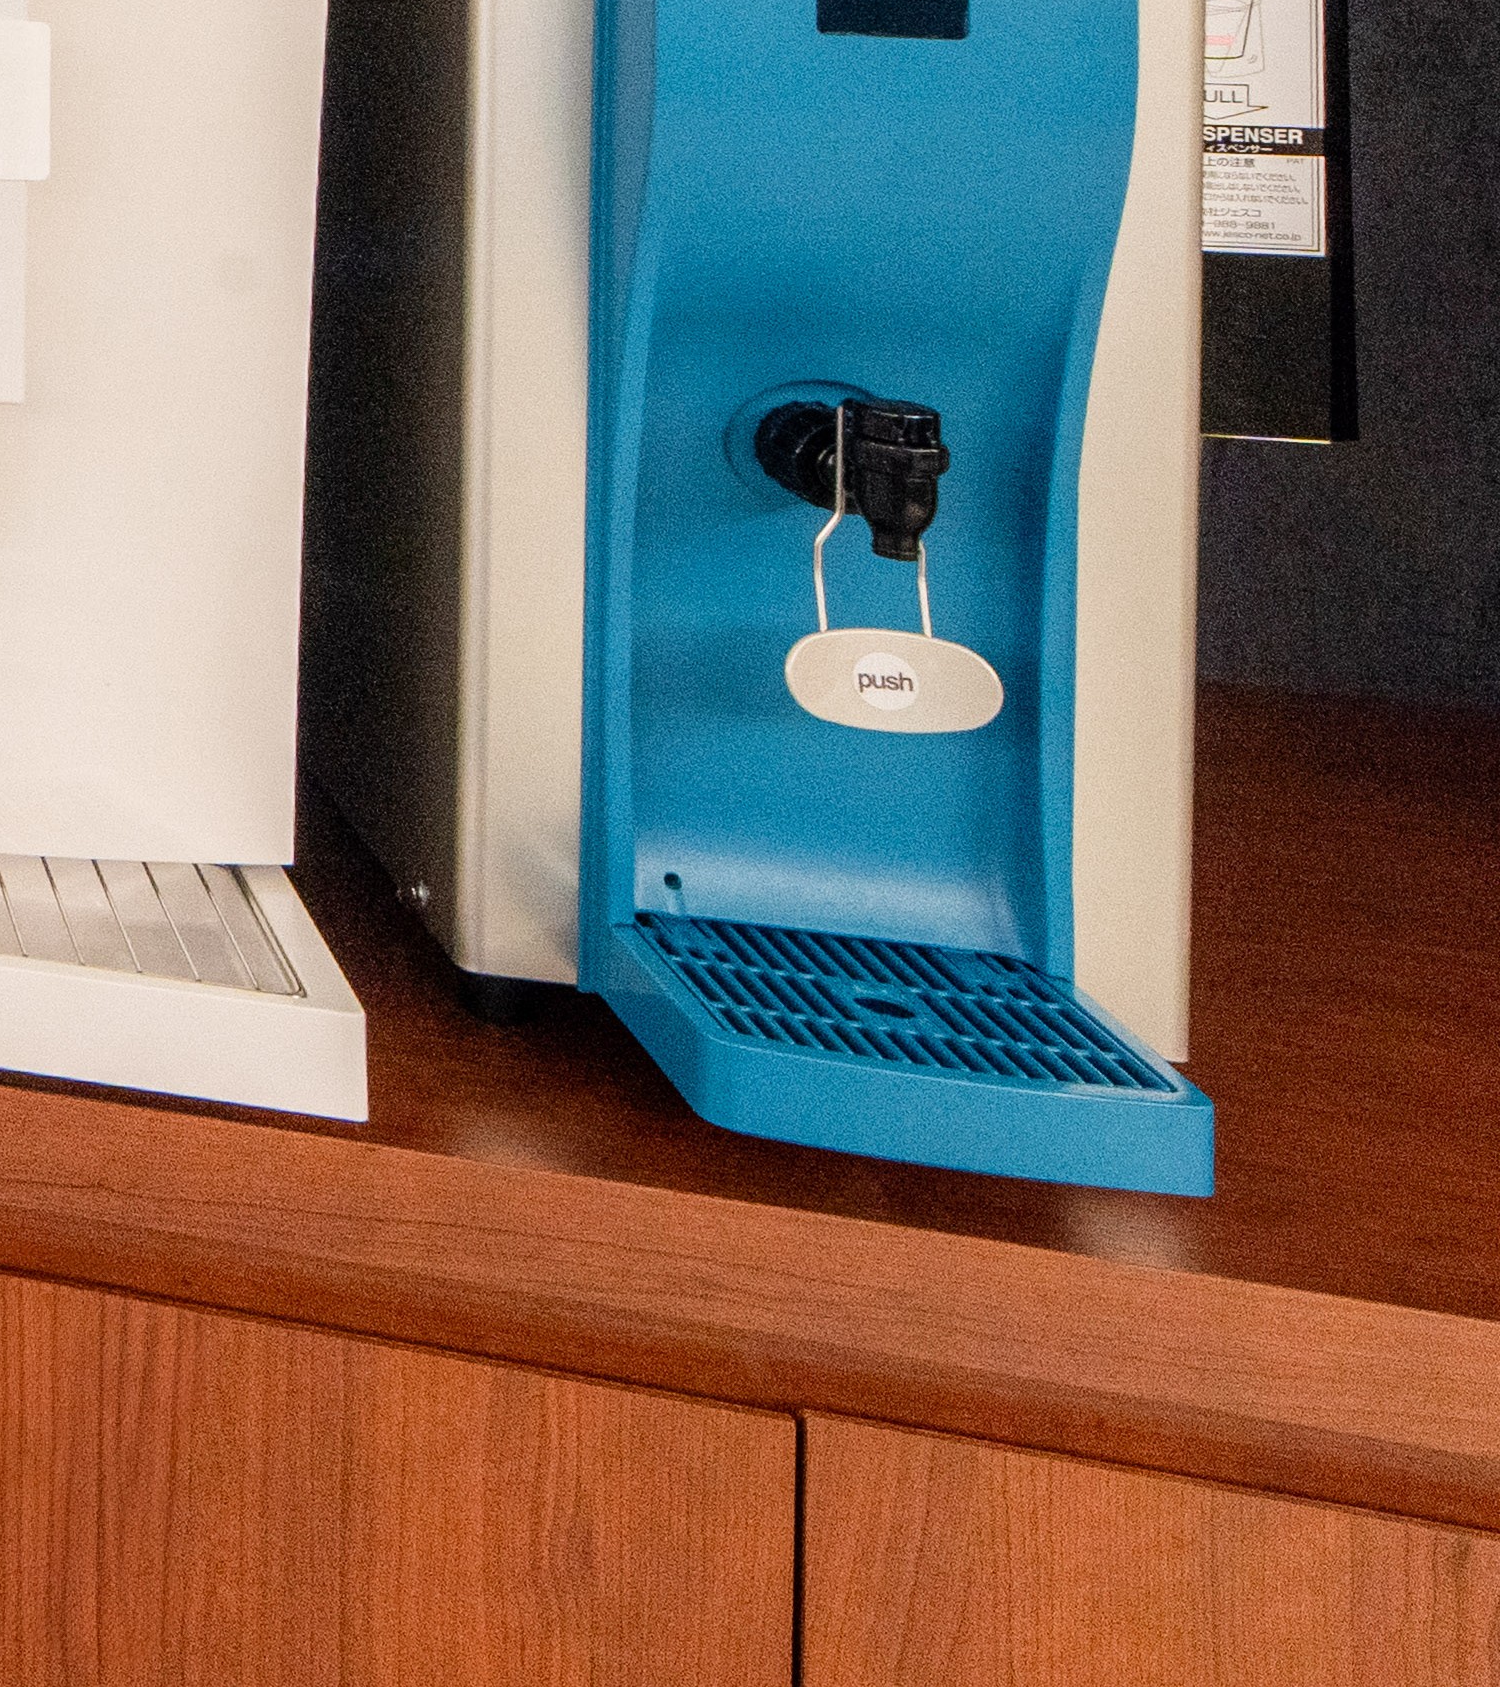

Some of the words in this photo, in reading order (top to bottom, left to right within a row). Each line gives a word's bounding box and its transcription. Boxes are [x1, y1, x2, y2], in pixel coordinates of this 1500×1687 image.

[1205, 90, 1244, 104] ULL
[1203, 126, 1304, 144] SPENSER
[1205, 156, 1255, 168] 上の注意
[858, 672, 913, 693] push
